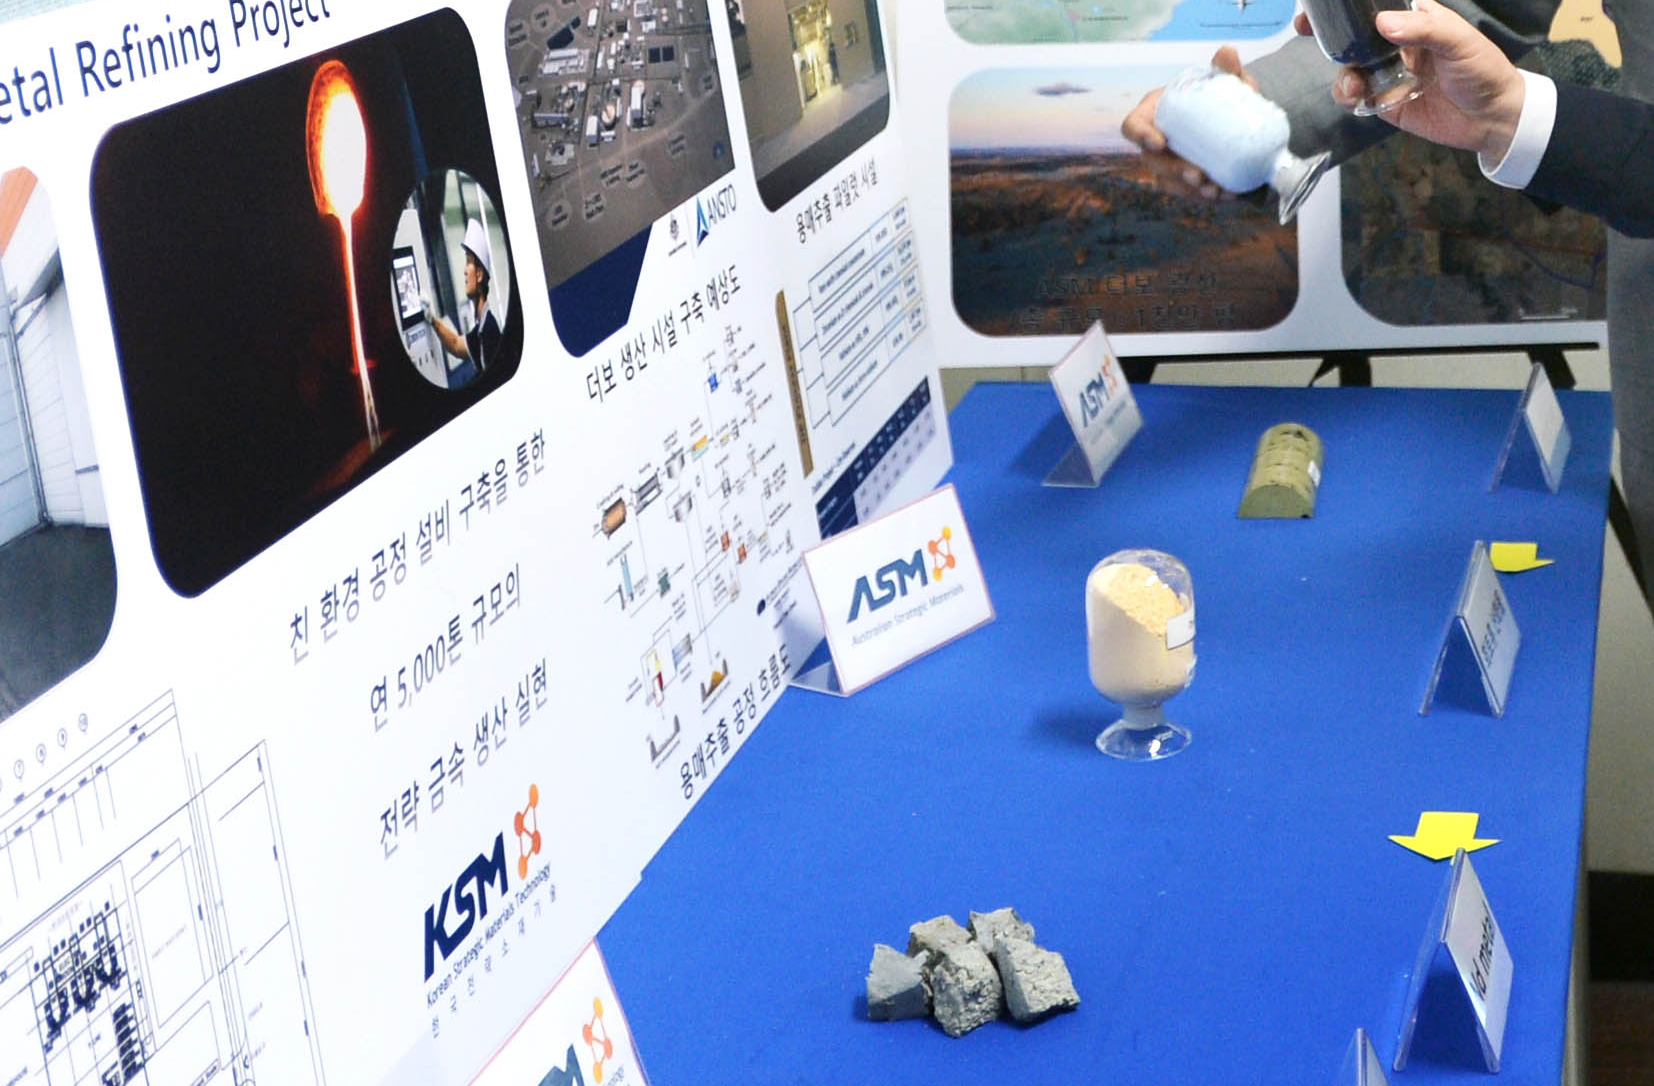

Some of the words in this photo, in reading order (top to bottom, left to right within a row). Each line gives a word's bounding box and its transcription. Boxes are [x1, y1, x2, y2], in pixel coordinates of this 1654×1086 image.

[75, 14, 222, 98] Refining
[586, 358, 617, 403] 더보
[620, 331, 648, 381] 생산
[651, 308, 678, 354] 시설
[680, 291, 705, 335] 구축
[706, 263, 741, 311] 예상도
[1079, 371, 1111, 428] ASM
[290, 604, 309, 667] 친
[320, 566, 360, 644] 환경
[369, 531, 407, 603] 공정
[415, 498, 451, 567] 설비
[458, 457, 509, 532] 구축을
[515, 427, 546, 488] 통한
[846, 547, 929, 624] ASM
[370, 674, 389, 734] 연
[397, 613, 464, 710] 5,000톤
[471, 561, 521, 645] 규모의
[380, 779, 421, 861] 전략
[428, 740, 465, 815] 금속
[473, 695, 508, 767] 생산
[515, 657, 549, 728] 실현
[680, 717, 731, 800] 용매추출
[732, 681, 757, 735] 공정
[758, 643, 792, 702] 흐름도
[424, 830, 509, 984] KSM
[452, 935, 484, 981] Strategic
[484, 902, 515, 945] Materials
[514, 860, 552, 909] Technology
